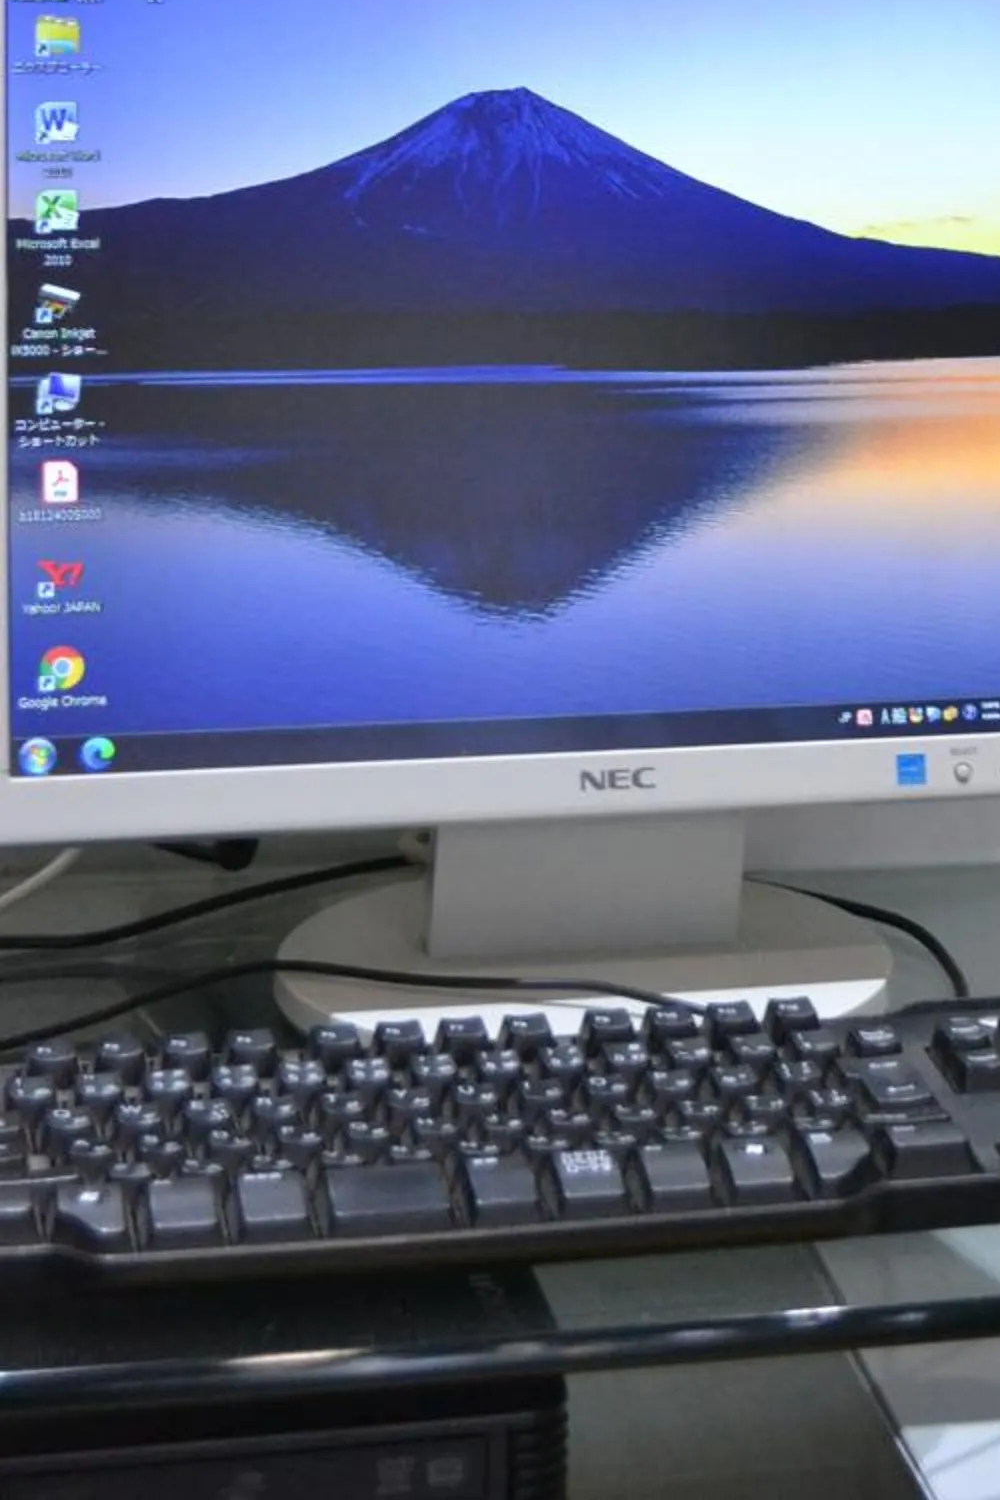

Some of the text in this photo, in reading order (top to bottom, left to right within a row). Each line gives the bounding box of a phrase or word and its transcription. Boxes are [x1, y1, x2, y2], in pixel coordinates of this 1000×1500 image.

[18, 695, 107, 711] Google Chrome
[580, 766, 656, 792] NEC
